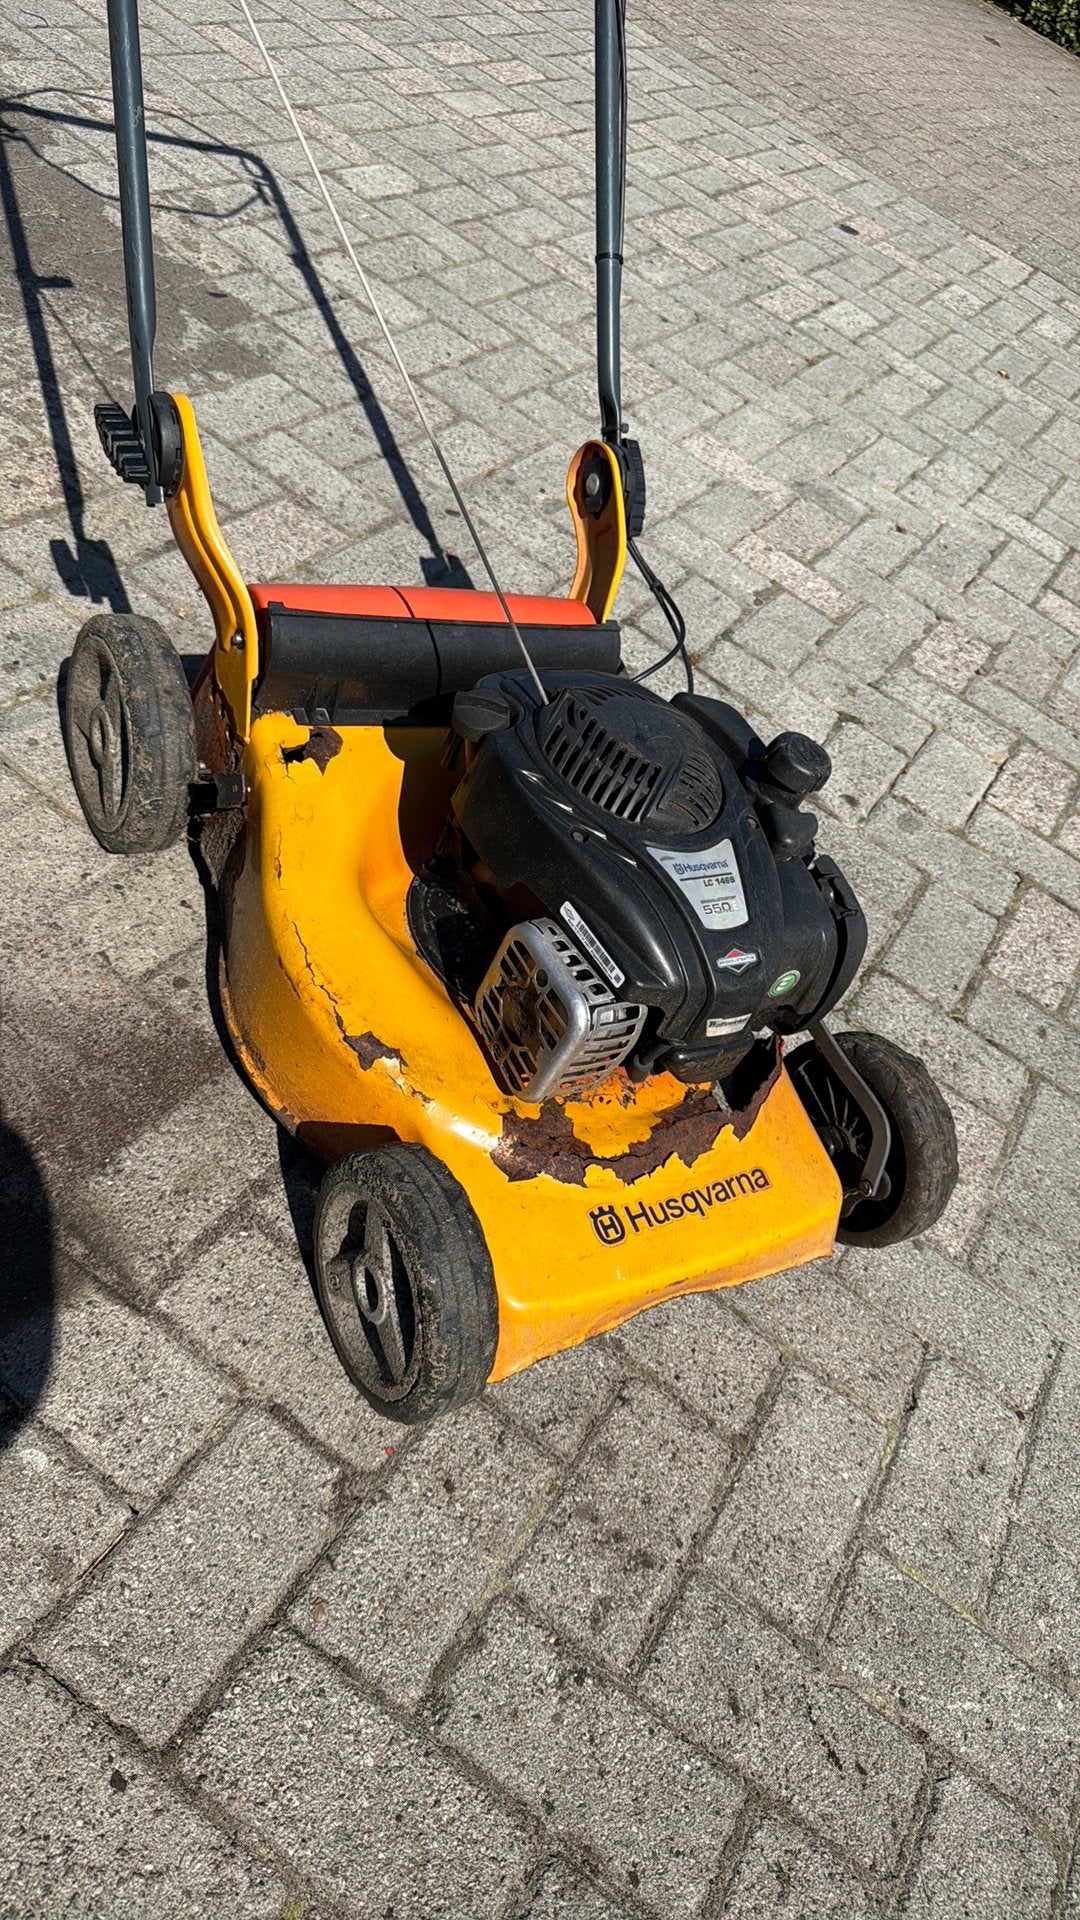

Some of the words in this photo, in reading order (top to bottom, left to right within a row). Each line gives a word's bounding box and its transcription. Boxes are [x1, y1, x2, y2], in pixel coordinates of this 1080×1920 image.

[684, 861, 728, 873] Husqvarna
[703, 879, 713, 887] LC
[624, 1168, 770, 1233] Husqvarna
